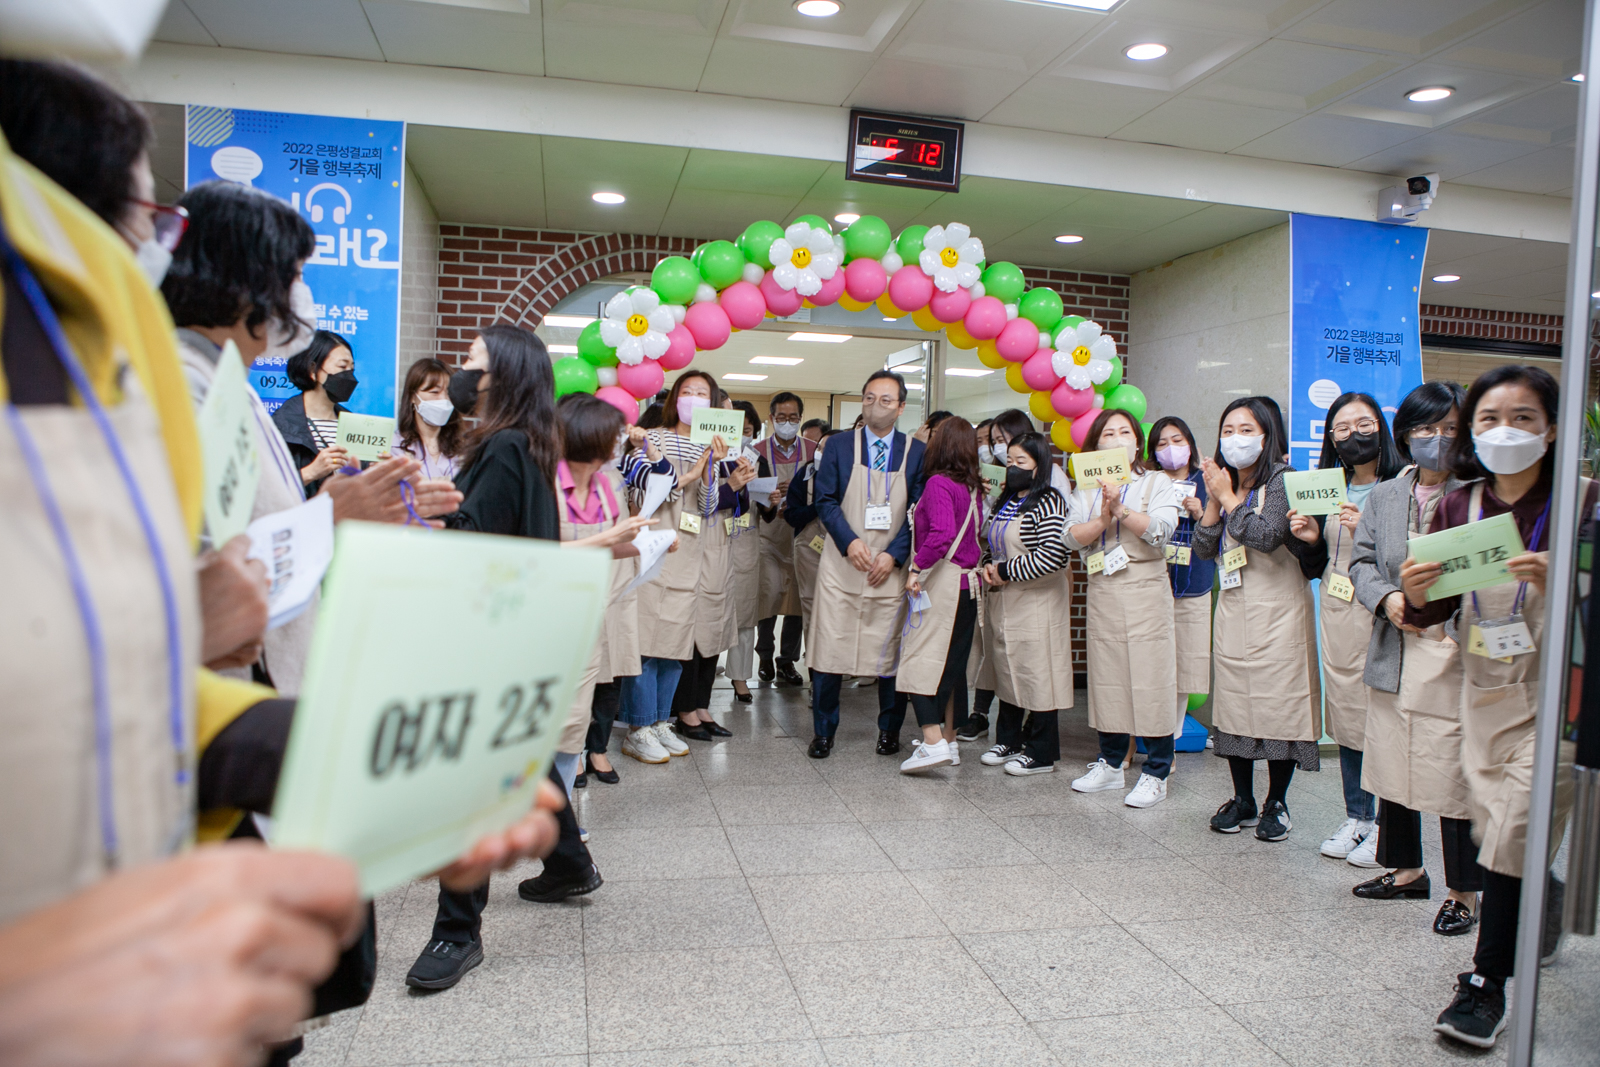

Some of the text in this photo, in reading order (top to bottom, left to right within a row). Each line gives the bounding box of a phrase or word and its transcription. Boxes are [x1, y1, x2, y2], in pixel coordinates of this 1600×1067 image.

[283, 142, 382, 160] 2022 은평성결교회
[918, 143, 941, 166] 12
[289, 158, 382, 180] 가을 행복축제
[329, 304, 342, 319] 수
[343, 305, 369, 321] 있는
[1323, 327, 1404, 346] 2022 은평성결교회
[1326, 345, 1401, 367] 가을 행복축제
[699, 422, 737, 434] 여자 10조
[346, 433, 387, 447] 여자 12조
[1083, 465, 1123, 477] 여자 8조
[1296, 488, 1340, 500] 여자 13조
[368, 675, 562, 779] 여자 2조
